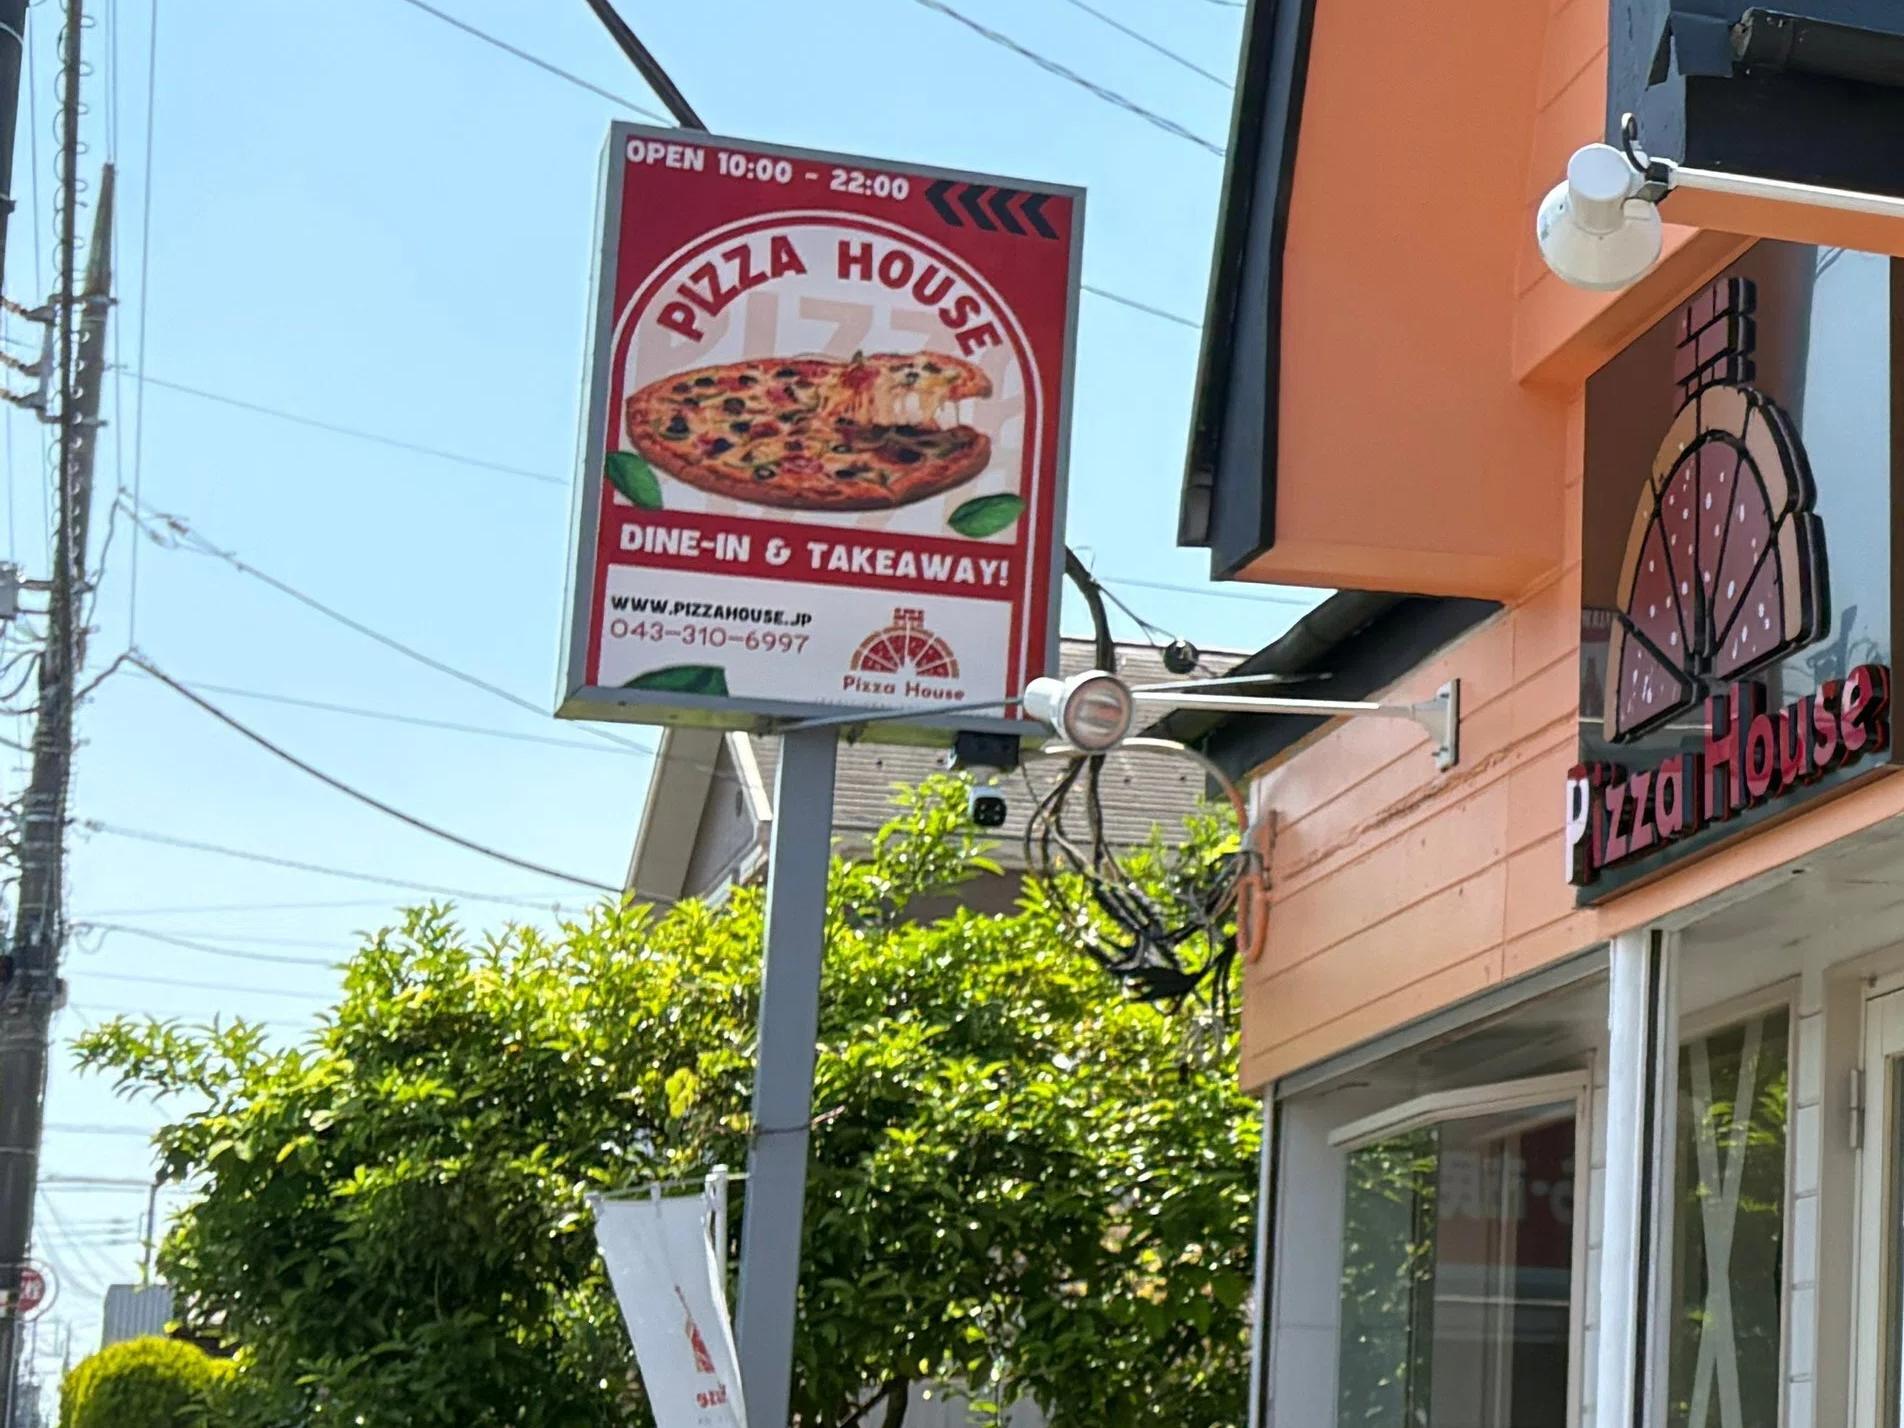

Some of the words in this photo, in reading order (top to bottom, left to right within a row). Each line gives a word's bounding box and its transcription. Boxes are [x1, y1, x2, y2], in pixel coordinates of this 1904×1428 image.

[626, 139, 705, 172] OPEN
[717, 151, 793, 184] 10:00
[829, 169, 909, 201] 22:00
[656, 235, 807, 343] PIZZA
[837, 240, 1003, 358] HOUSE
[619, 523, 750, 563] DINE-IN
[765, 538, 792, 566] &
[806, 541, 1009, 586] TAKEAWAY!
[610, 618, 810, 654] 043-310-6997
[611, 595, 812, 627] WWW.PIZZAHOUSE.JP
[843, 674, 895, 695] Pizza
[904, 680, 965, 702] House
[1566, 755, 1690, 885] Pizza
[1704, 664, 1886, 820] House
